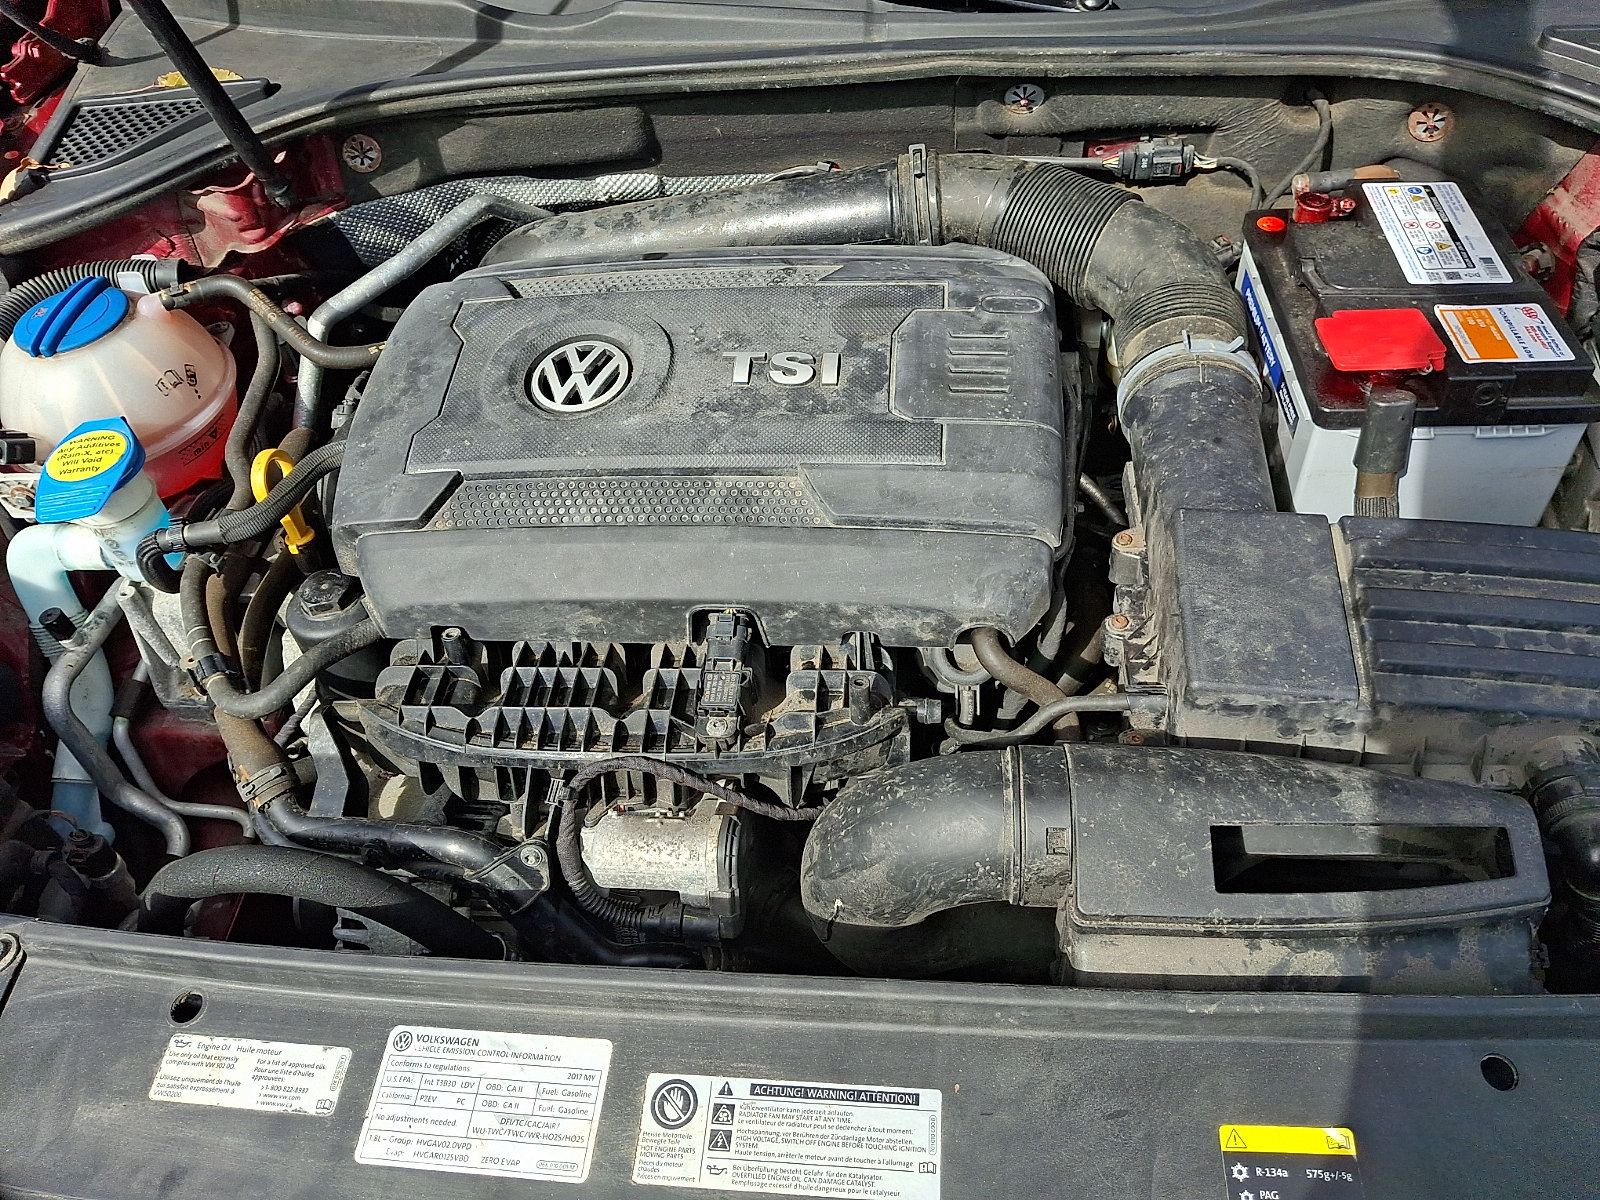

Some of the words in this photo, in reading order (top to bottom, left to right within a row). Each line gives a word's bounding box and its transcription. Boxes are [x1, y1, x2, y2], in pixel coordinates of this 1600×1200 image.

[1497, 307, 1525, 347] NONSPILLABLE
[722, 351, 842, 387] TSI
[60, 466, 100, 475] Warranty
[416, 1034, 479, 1047] VOLKSWAGEN
[197, 1042, 220, 1052] Engine
[237, 1045, 255, 1054] Huile
[257, 1047, 282, 1055] moteur
[442, 1047, 476, 1056] EMISSION
[477, 1049, 508, 1058] CONTROL
[510, 1051, 562, 1062] INFORMATION
[390, 1059, 422, 1068] Conforms
[567, 1072, 582, 1080] 2017
[486, 1083, 504, 1092] OBD:
[542, 1088, 558, 1096] Fuel:
[562, 1089, 592, 1098] Gasoline
[754, 1085, 804, 1097] ACHTUNG!
[807, 1088, 857, 1100] WARNING!
[860, 1092, 916, 1104] ATTENTION!
[456, 1097, 465, 1105] PC
[539, 1104, 555, 1113] Fuel:
[558, 1106, 589, 1115] Gasoline
[386, 1114, 428, 1125] adjustments
[739, 1111, 767, 1119] RADIATOR
[389, 1135, 414, 1146] Group:
[817, 1140, 840, 1148] ENGINE
[865, 1143, 897, 1152] TOUCHING
[481, 1157, 499, 1165] ZERO
[501, 1158, 521, 1166] EVAP
[732, 1172, 766, 1180] OVERFILLED
[768, 1174, 790, 1182] ENGINE
[818, 1178, 845, 1186] DAMAGE
[1256, 1167, 1288, 1178] R-134a
[1306, 1169, 1352, 1182] 575g+/-5g
[1260, 1190, 1279, 1200] PAG
